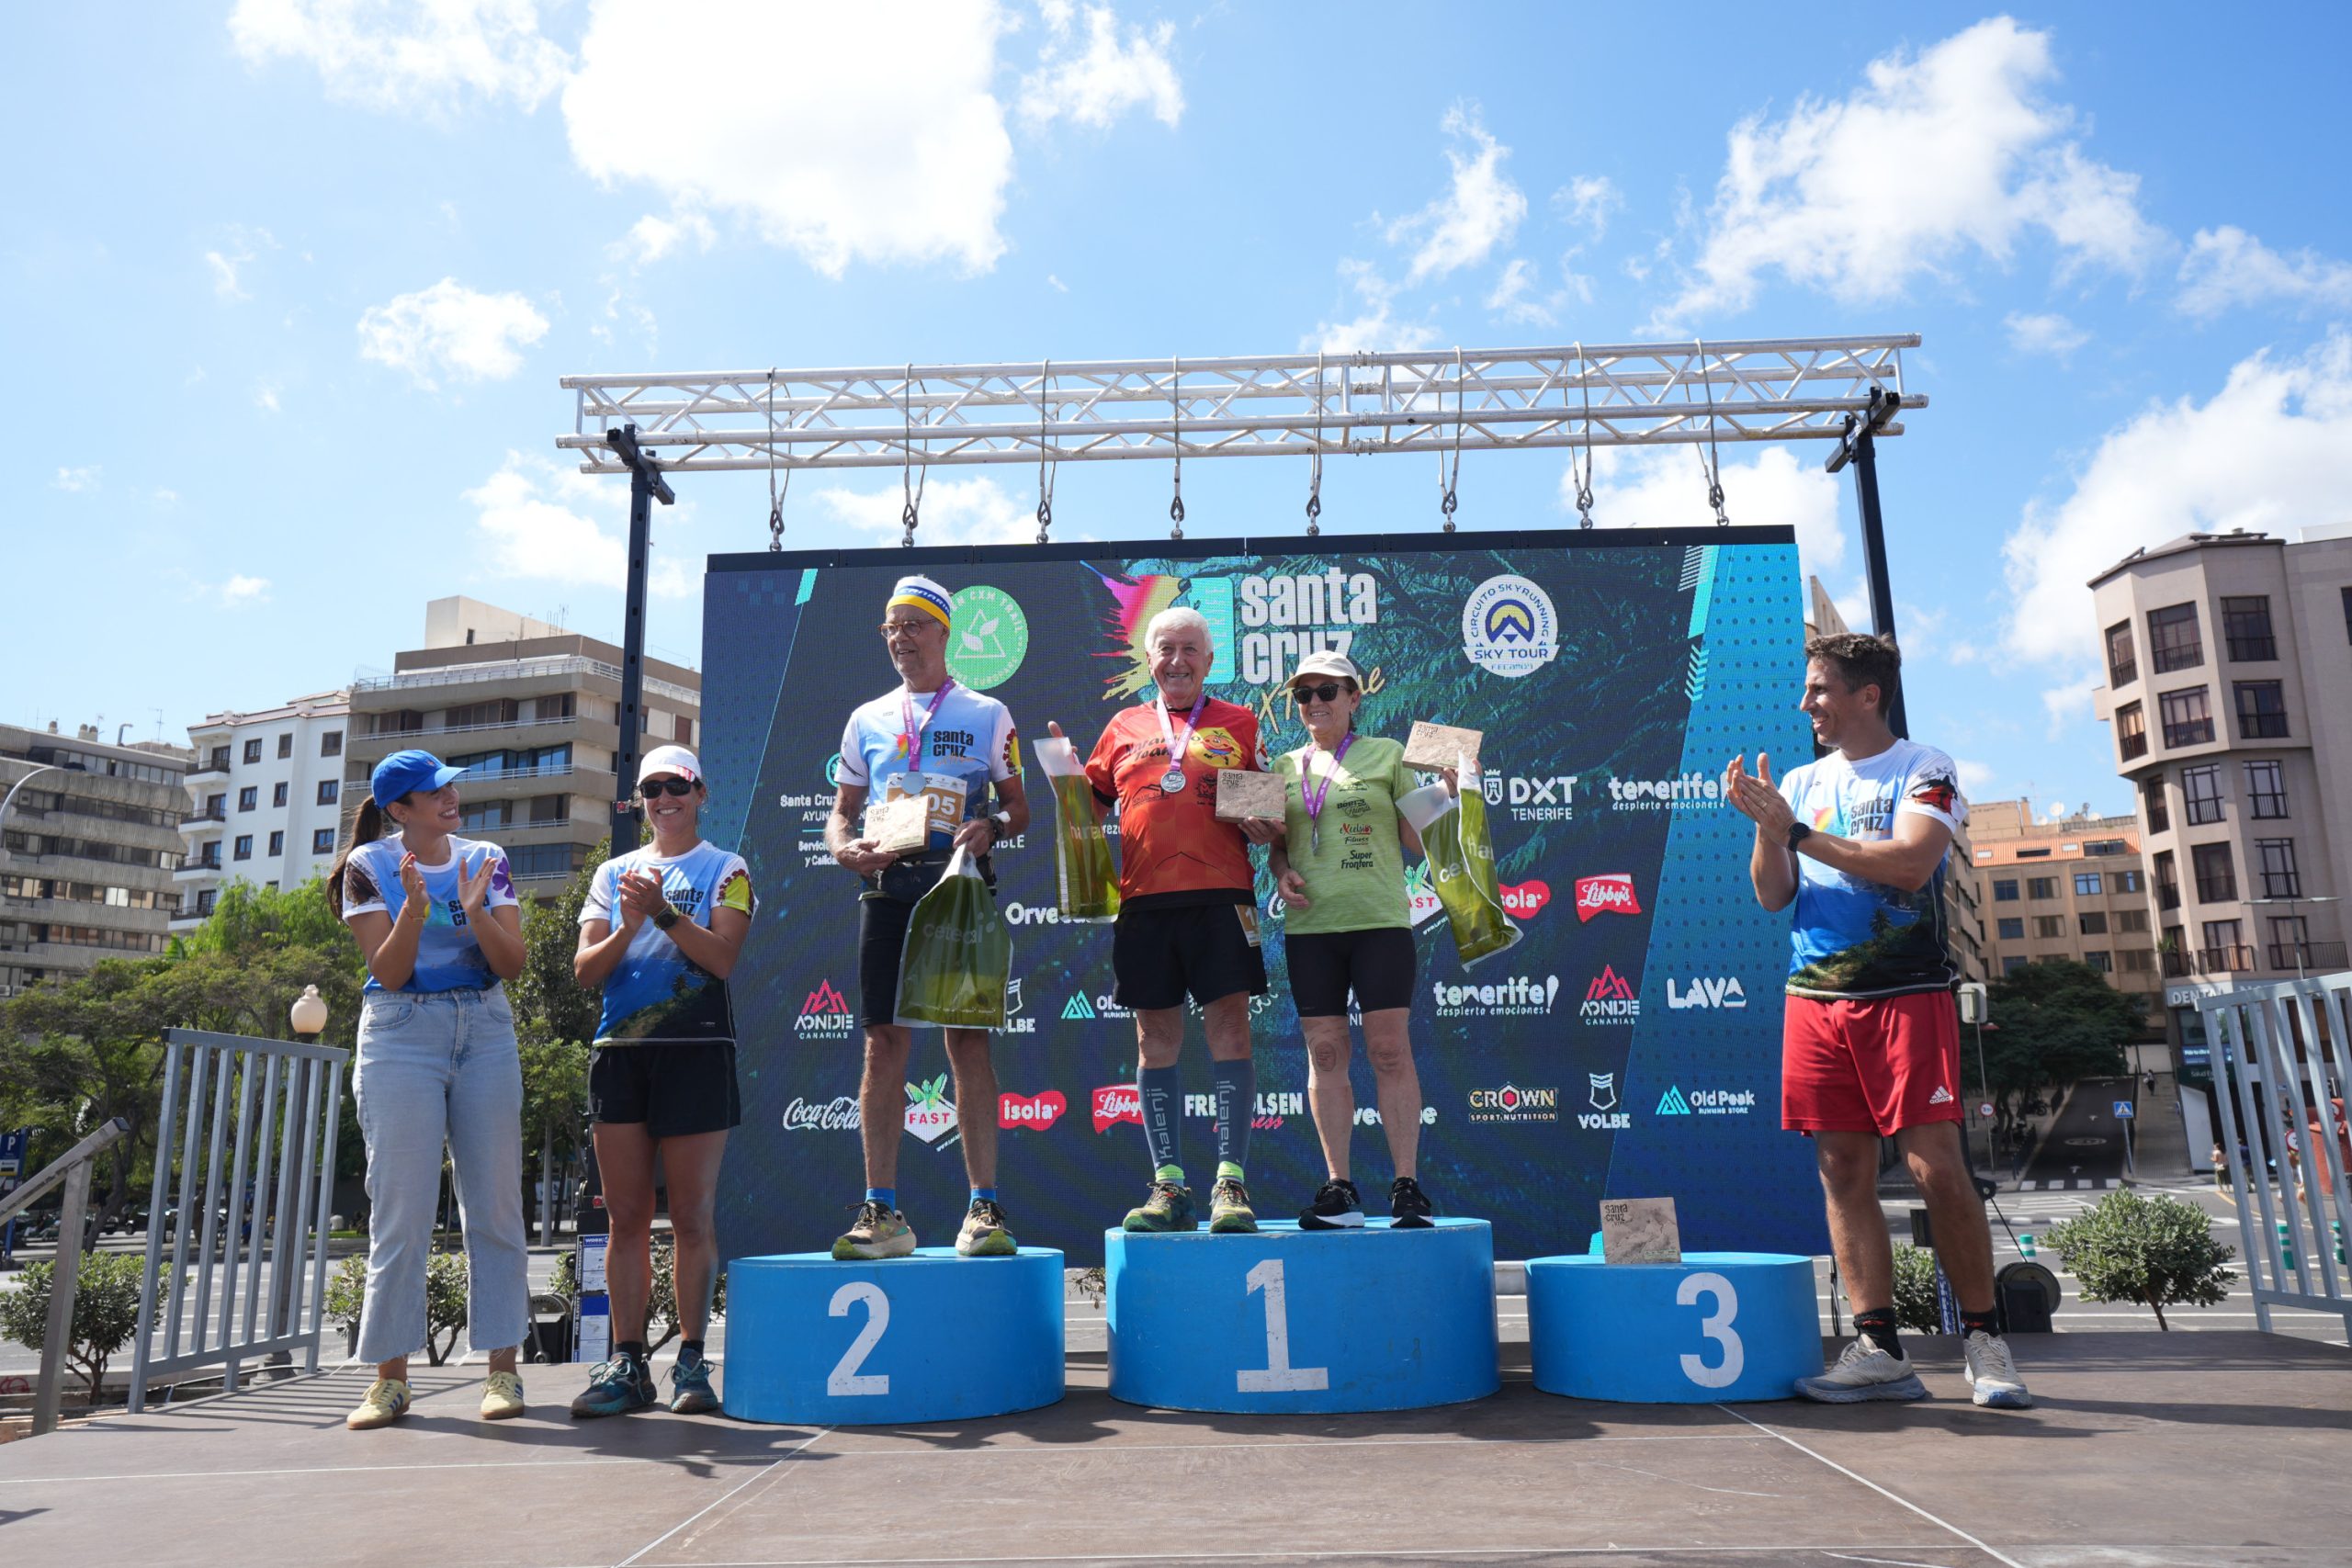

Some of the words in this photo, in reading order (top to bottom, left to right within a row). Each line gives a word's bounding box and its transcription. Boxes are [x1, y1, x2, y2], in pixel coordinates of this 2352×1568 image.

[1240, 567, 1377, 626] santa
[1471, 588, 1497, 637] CIRCUITO
[1498, 583, 1550, 637] SKYRUNNING
[1475, 649, 1504, 660] SKY
[1509, 648, 1549, 660] TOUR
[933, 729, 974, 746] santa
[933, 742, 967, 757] cruz
[780, 795, 811, 807] Santa
[1510, 776, 1577, 805] DXT
[1510, 807, 1572, 820] TENERIFE
[1850, 796, 1893, 819] santa
[1850, 815, 1883, 837] cruz
[1341, 860, 1374, 870] Frontera
[1350, 850, 1373, 861] Super
[1578, 882, 1631, 907] Libby's
[1433, 975, 1559, 1014] tenerife!
[1668, 977, 1747, 1009] LAVA
[1470, 1085, 1555, 1112] CROWN
[1690, 1090, 1716, 1107] Old
[1718, 1089, 1755, 1106] Peak
[910, 1112, 950, 1124] FAST
[1004, 1099, 1054, 1120] isola
[1217, 1080, 1237, 1156] kalenji
[1471, 1113, 1500, 1122] SPORT
[1504, 1112, 1555, 1122] NUTRITION
[1147, 1088, 1173, 1159] kalenji
[1577, 1113, 1631, 1129] VOLBE
[7, 1136, 16, 1151] P
[1605, 1203, 1628, 1213] santa
[1605, 1213, 1625, 1222] cruz
[1237, 1259, 1329, 1392] 1
[1677, 1272, 1744, 1388] 3
[827, 1281, 889, 1396] 2
